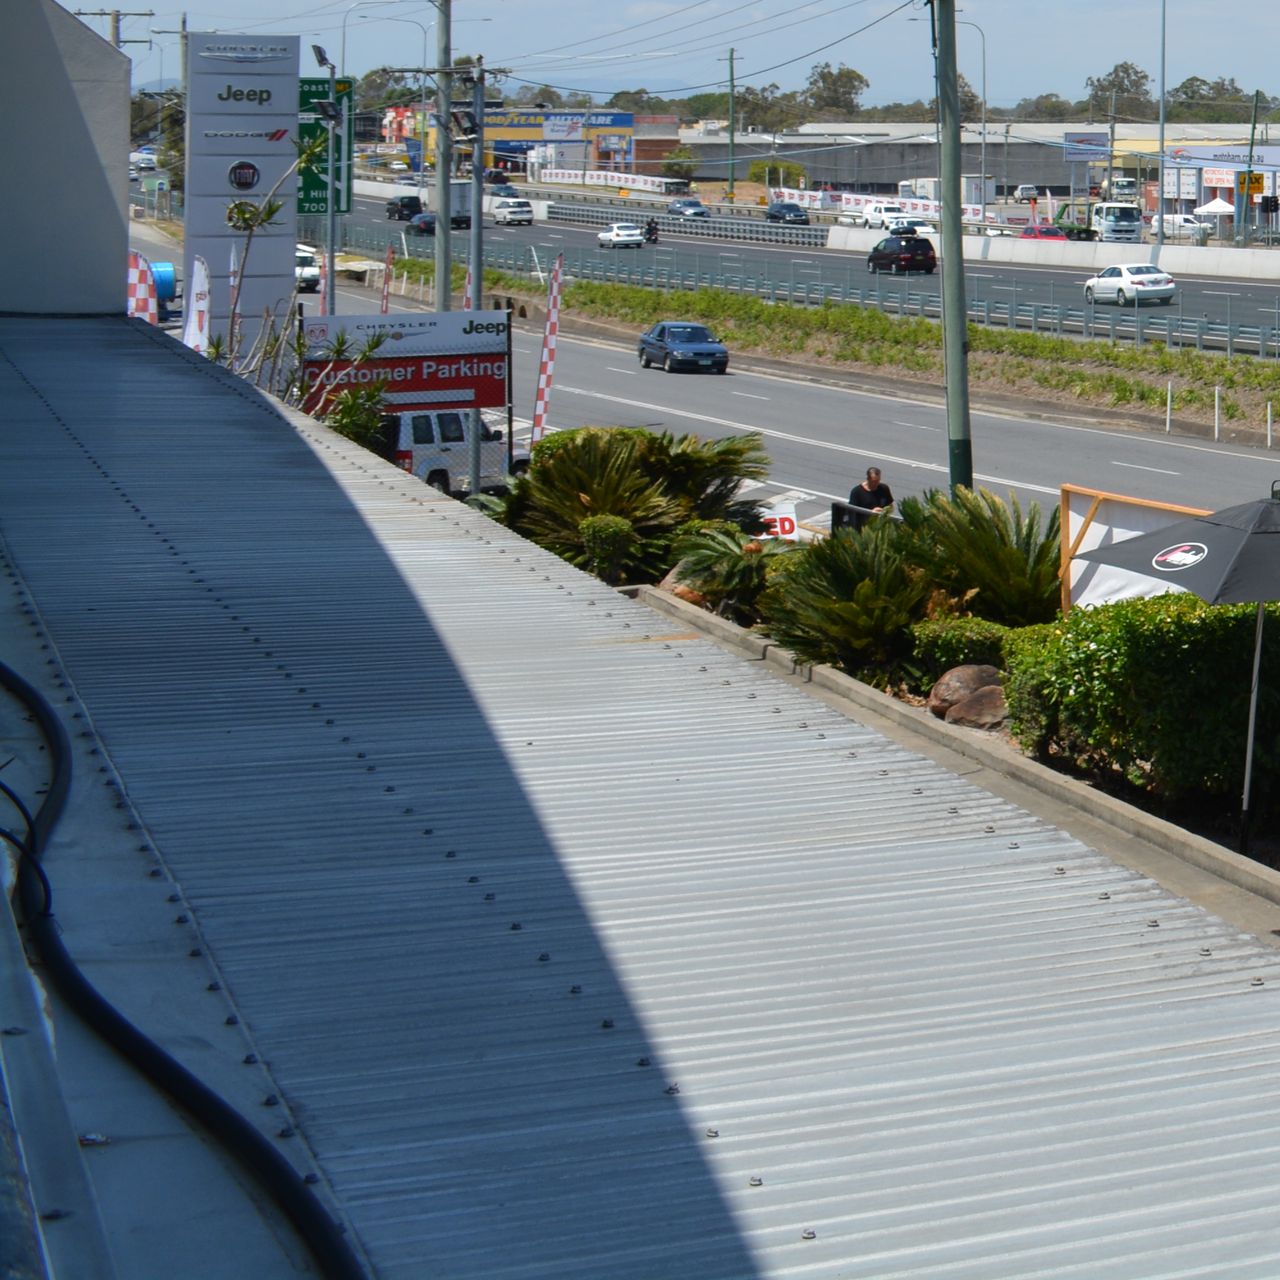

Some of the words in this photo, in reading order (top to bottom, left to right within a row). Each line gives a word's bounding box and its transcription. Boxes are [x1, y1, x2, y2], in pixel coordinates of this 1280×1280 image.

[217, 85, 272, 105] Jeep
[310, 190, 330, 198] Hill
[356, 321, 438, 331] CHRYSLER
[462, 320, 507, 336] Jeep
[304, 365, 416, 385] Customer
[422, 358, 507, 379] Parking
